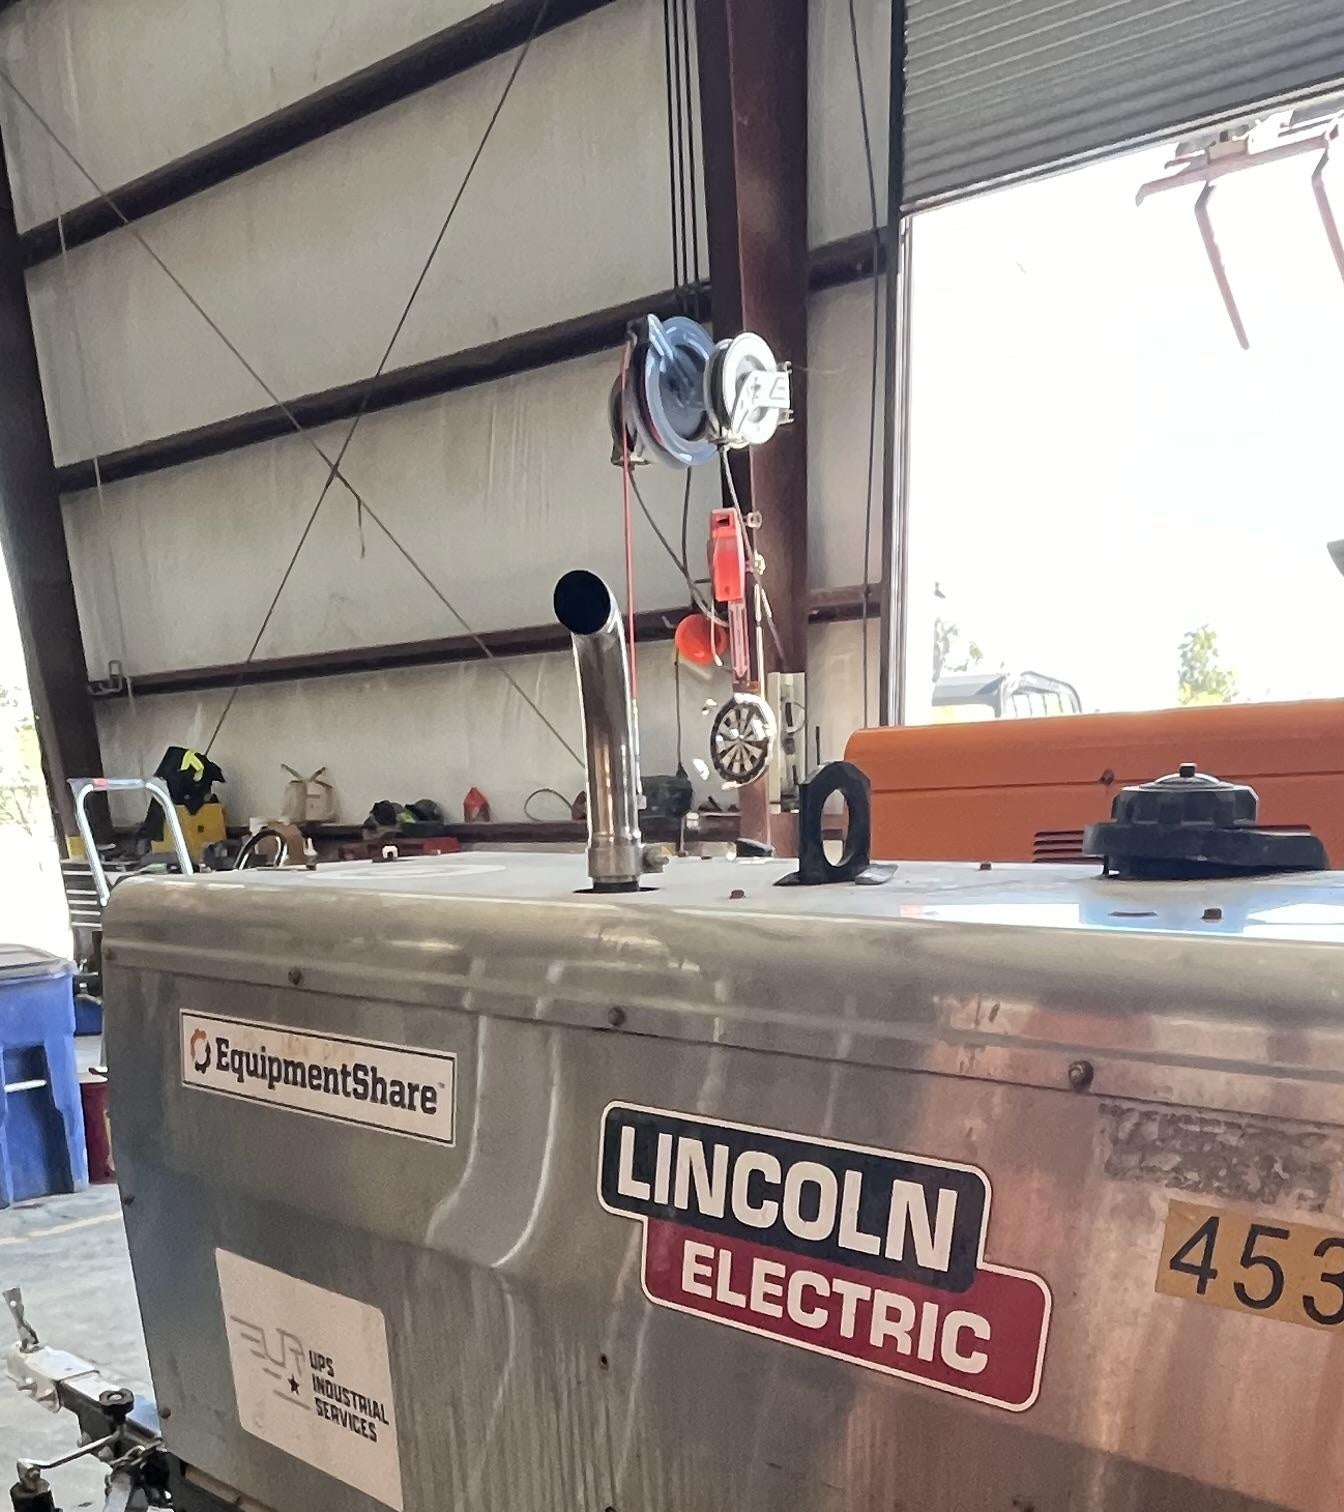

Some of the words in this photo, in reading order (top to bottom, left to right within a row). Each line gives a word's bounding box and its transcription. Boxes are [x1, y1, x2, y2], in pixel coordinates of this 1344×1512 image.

[215, 1037, 438, 1115] EquipmentShare
[617, 1126, 958, 1272] LINCOLN
[681, 1239, 991, 1374] ELECTRIC
[308, 1349, 335, 1378] UPS
[311, 1373, 390, 1426] INDUSTRIAL
[314, 1396, 378, 1443] SERVICES
